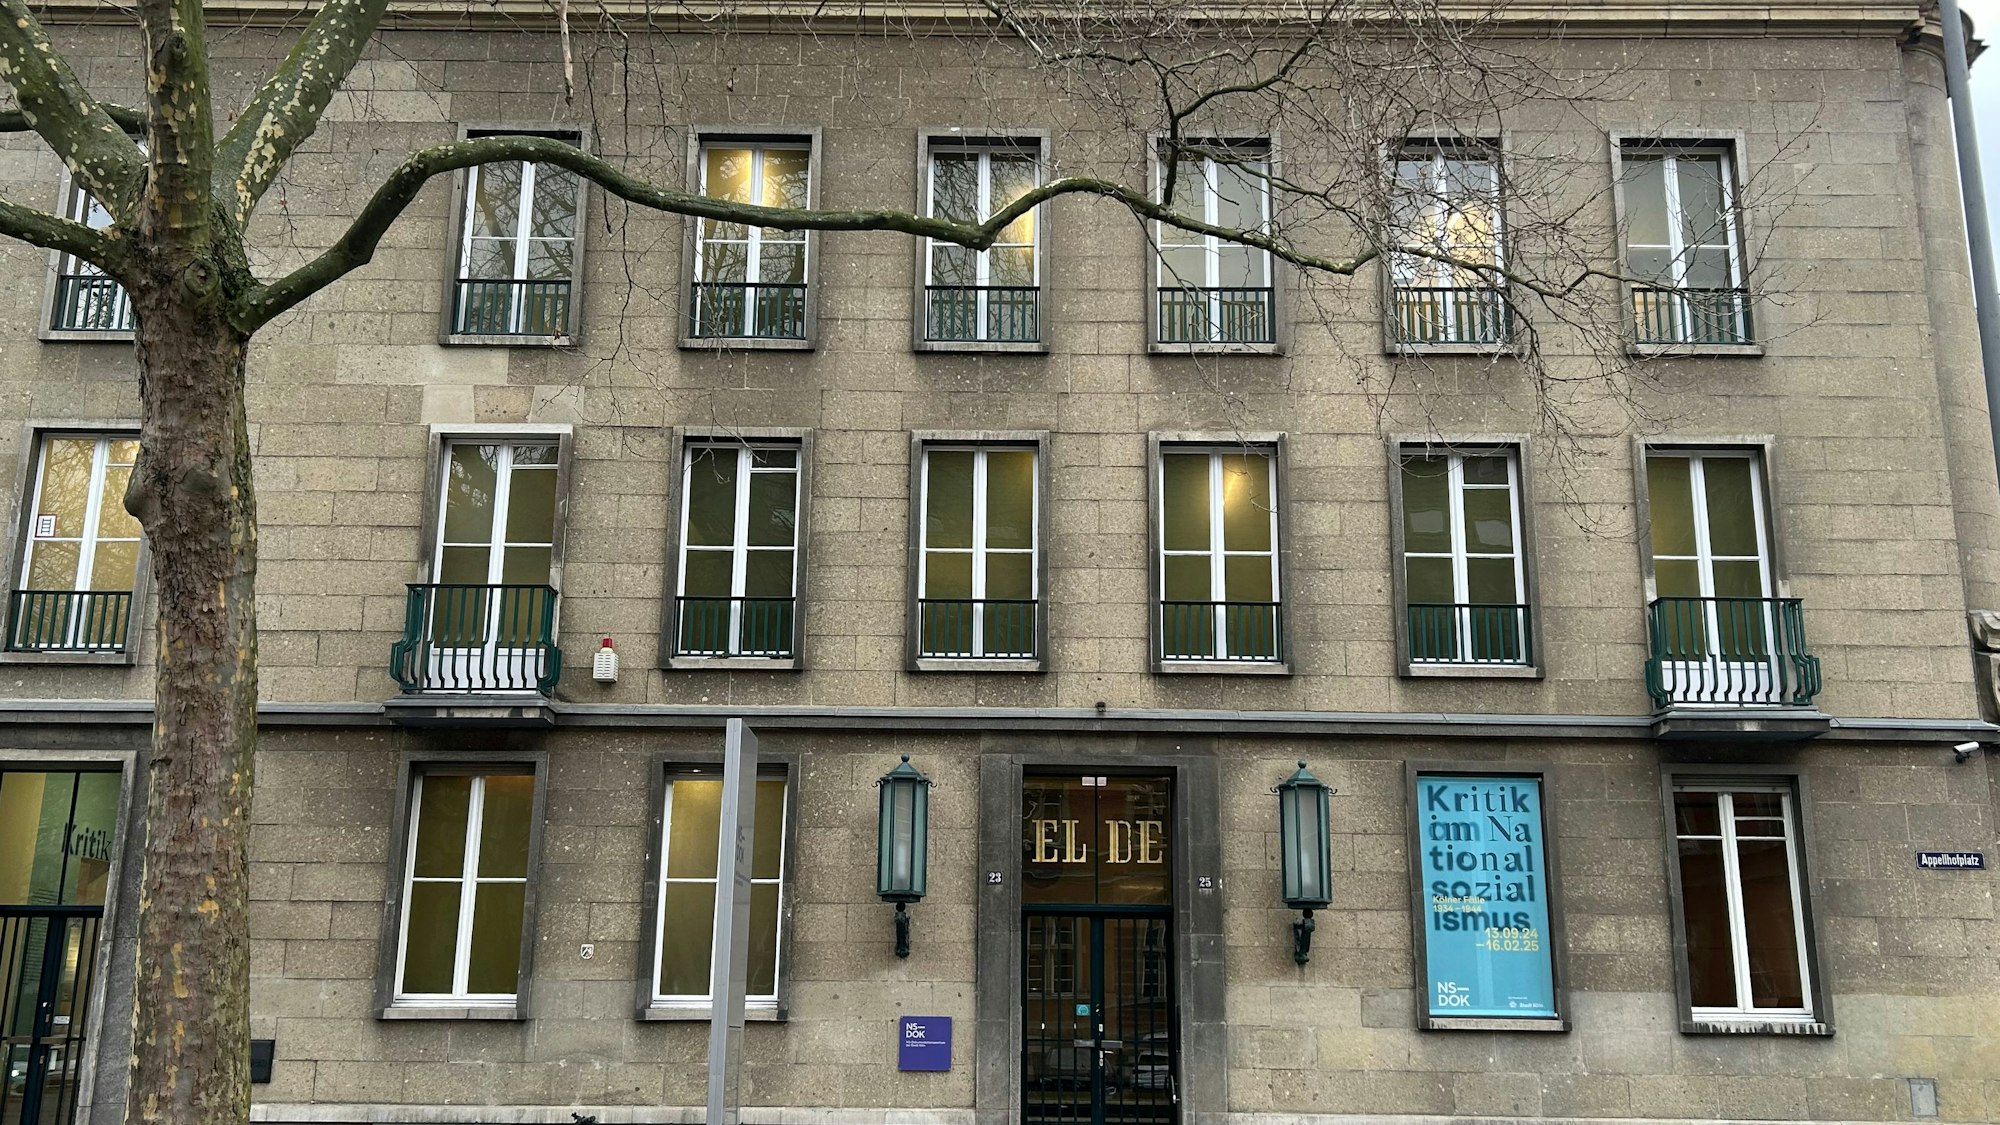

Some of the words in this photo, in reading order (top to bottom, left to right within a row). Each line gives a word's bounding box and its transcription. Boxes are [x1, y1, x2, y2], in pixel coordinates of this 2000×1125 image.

[1427, 785, 1530, 813] Kritik
[1487, 815, 1532, 842] Na
[61, 823, 111, 861] Kritik
[1032, 820, 1087, 863] EL
[1105, 820, 1162, 863] DE
[1429, 845, 1534, 872] tional
[1921, 853, 1980, 867] Appellhofplatz
[989, 871, 1002, 883] 23
[1199, 876, 1211, 888] 25
[1431, 874, 1535, 902] sozial
[1433, 895, 1462, 904] Kölner
[1434, 907, 1530, 932] ismus
[1485, 927, 1539, 939] 13.09.24
[1438, 995, 1471, 1006] DOK
[906, 1031, 926, 1039] DOK
